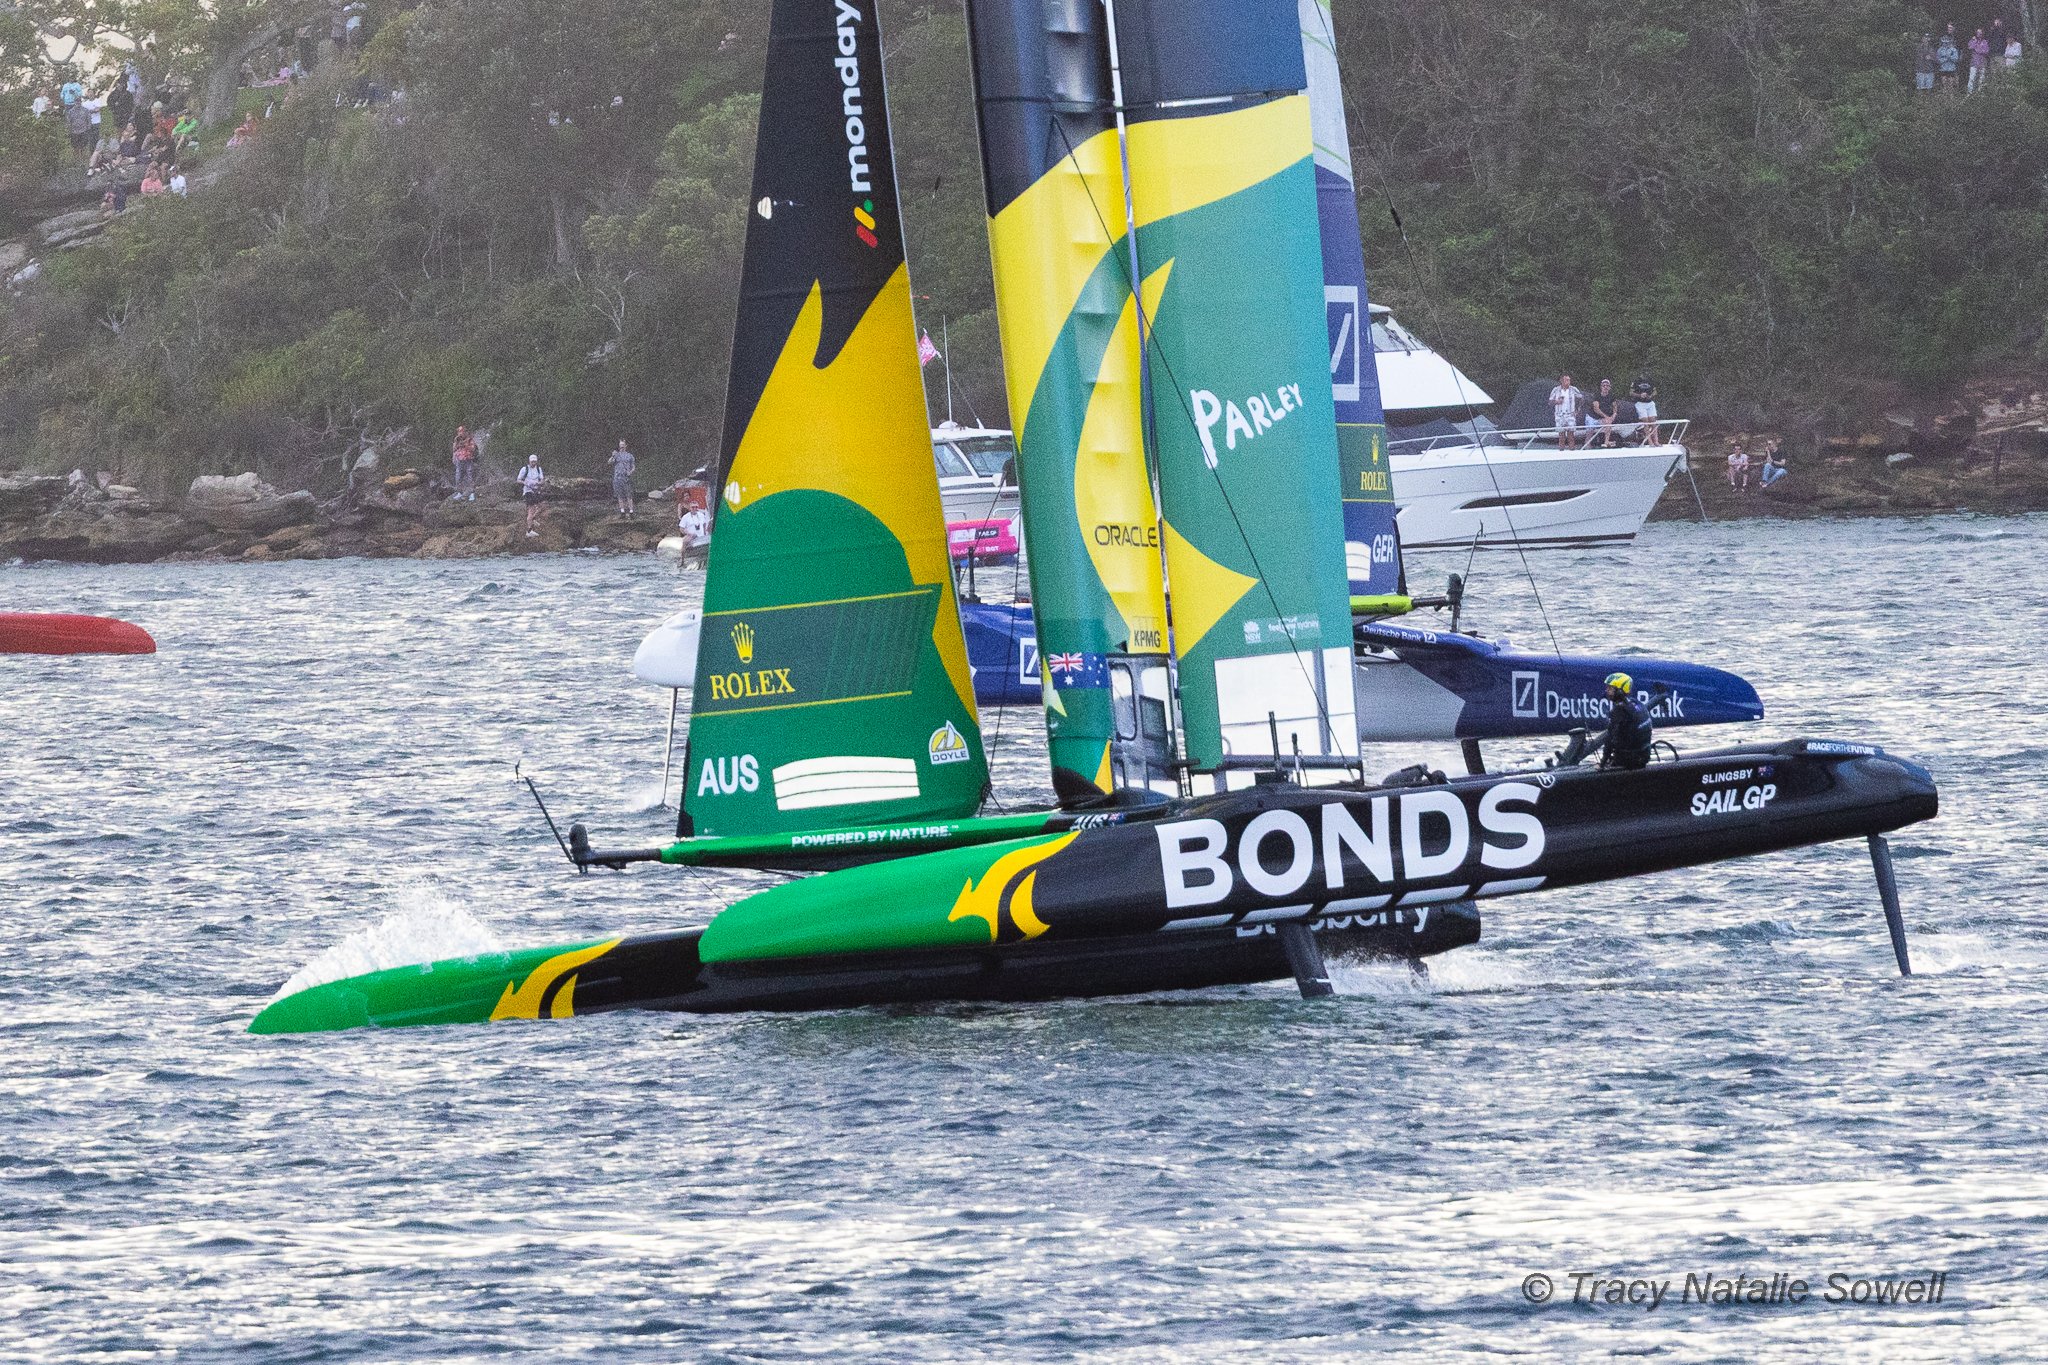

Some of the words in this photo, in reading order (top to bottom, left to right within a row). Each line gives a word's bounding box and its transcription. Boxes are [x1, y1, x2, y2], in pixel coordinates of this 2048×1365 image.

[834, 0, 871, 191] monday
[1190, 382, 1303, 469] PARLEY
[1361, 472, 1387, 491] ROLEX
[1094, 525, 1158, 547] ORACLE
[1373, 533, 1394, 563] GER
[1134, 630, 1161, 648] KPMG
[1362, 625, 1400, 639] Deutsche
[1401, 631, 1421, 641] Bank
[710, 669, 795, 700] ROLEX
[1546, 691, 1613, 718] Deutsc
[932, 750, 968, 763] DOYLE
[698, 754, 759, 796] AUS
[1702, 769, 1753, 784] SLINGSBY
[791, 831, 866, 847] POWERED
[867, 829, 887, 842] BY
